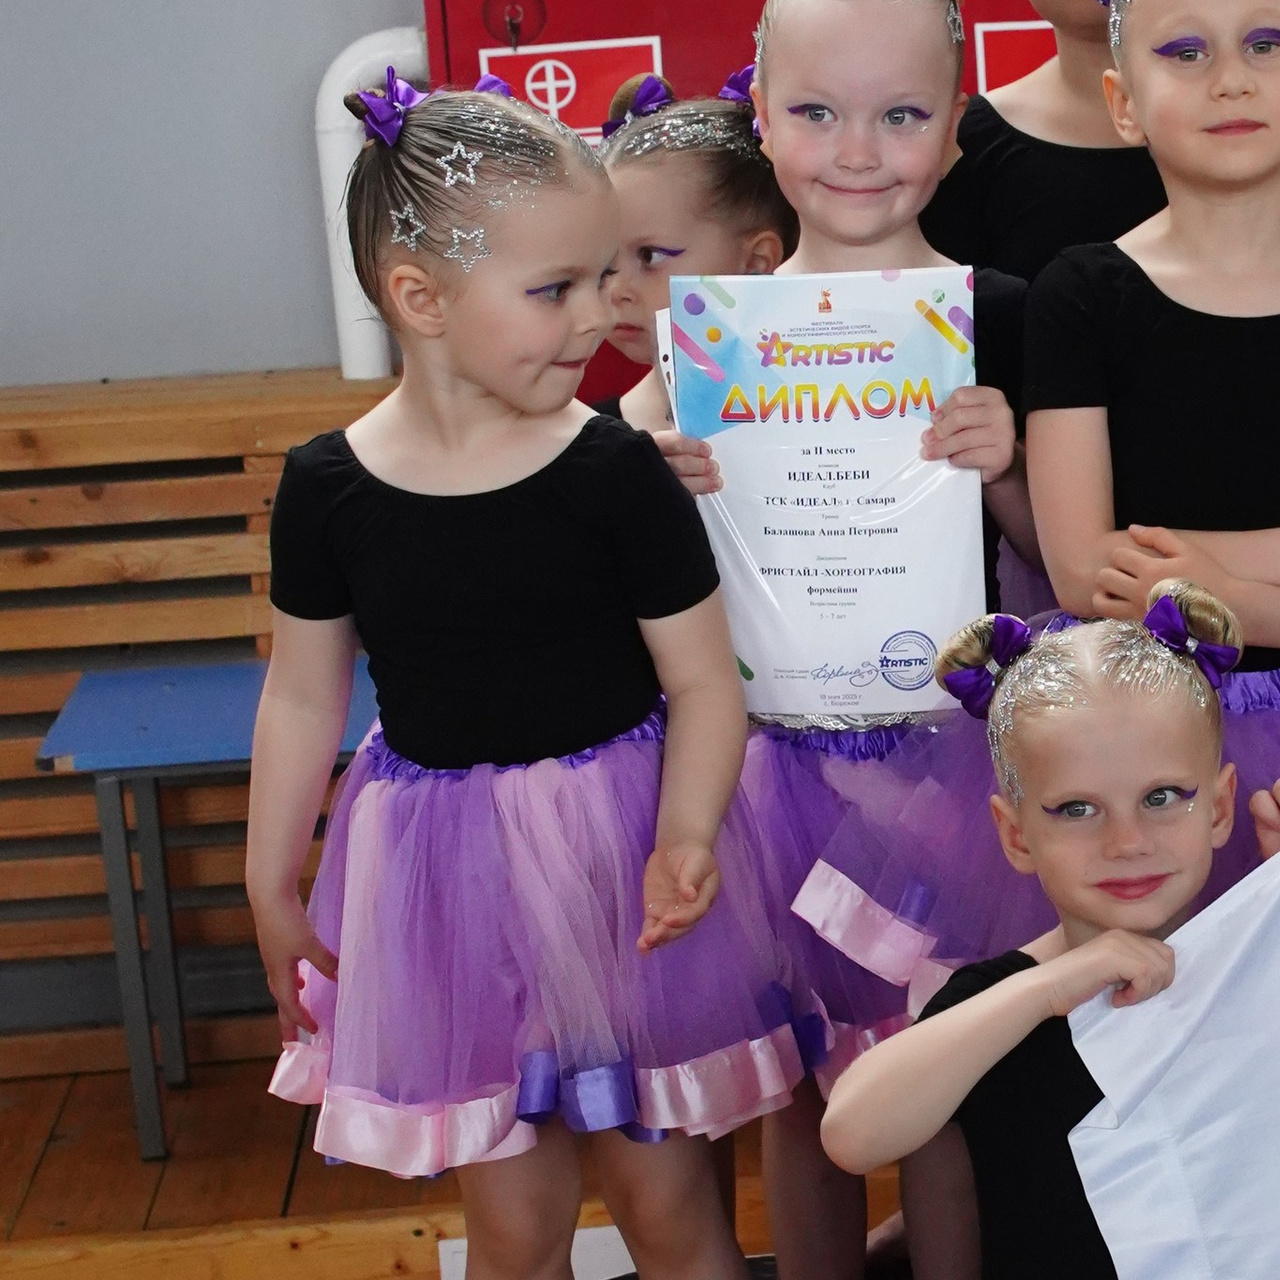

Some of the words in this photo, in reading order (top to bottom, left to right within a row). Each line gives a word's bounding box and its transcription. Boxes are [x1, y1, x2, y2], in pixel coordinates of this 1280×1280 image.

[757, 332, 895, 367] ARTISTIC
[721, 377, 937, 423] ДИПЛОМ
[826, 447, 856, 455] место
[788, 470, 870, 482] ИДЕАЛ.БЕБИ
[764, 496, 787, 506] ТСК
[790, 496, 842, 507] «ИДЕАЛ»
[857, 496, 896, 506] Самара
[764, 526, 815, 536] Балашова
[818, 527, 845, 536] Анна
[849, 526, 898, 537] Петровна
[759, 567, 818, 577] ФРИСТАЙЛ
[879, 655, 928, 668] ARTISTIC
